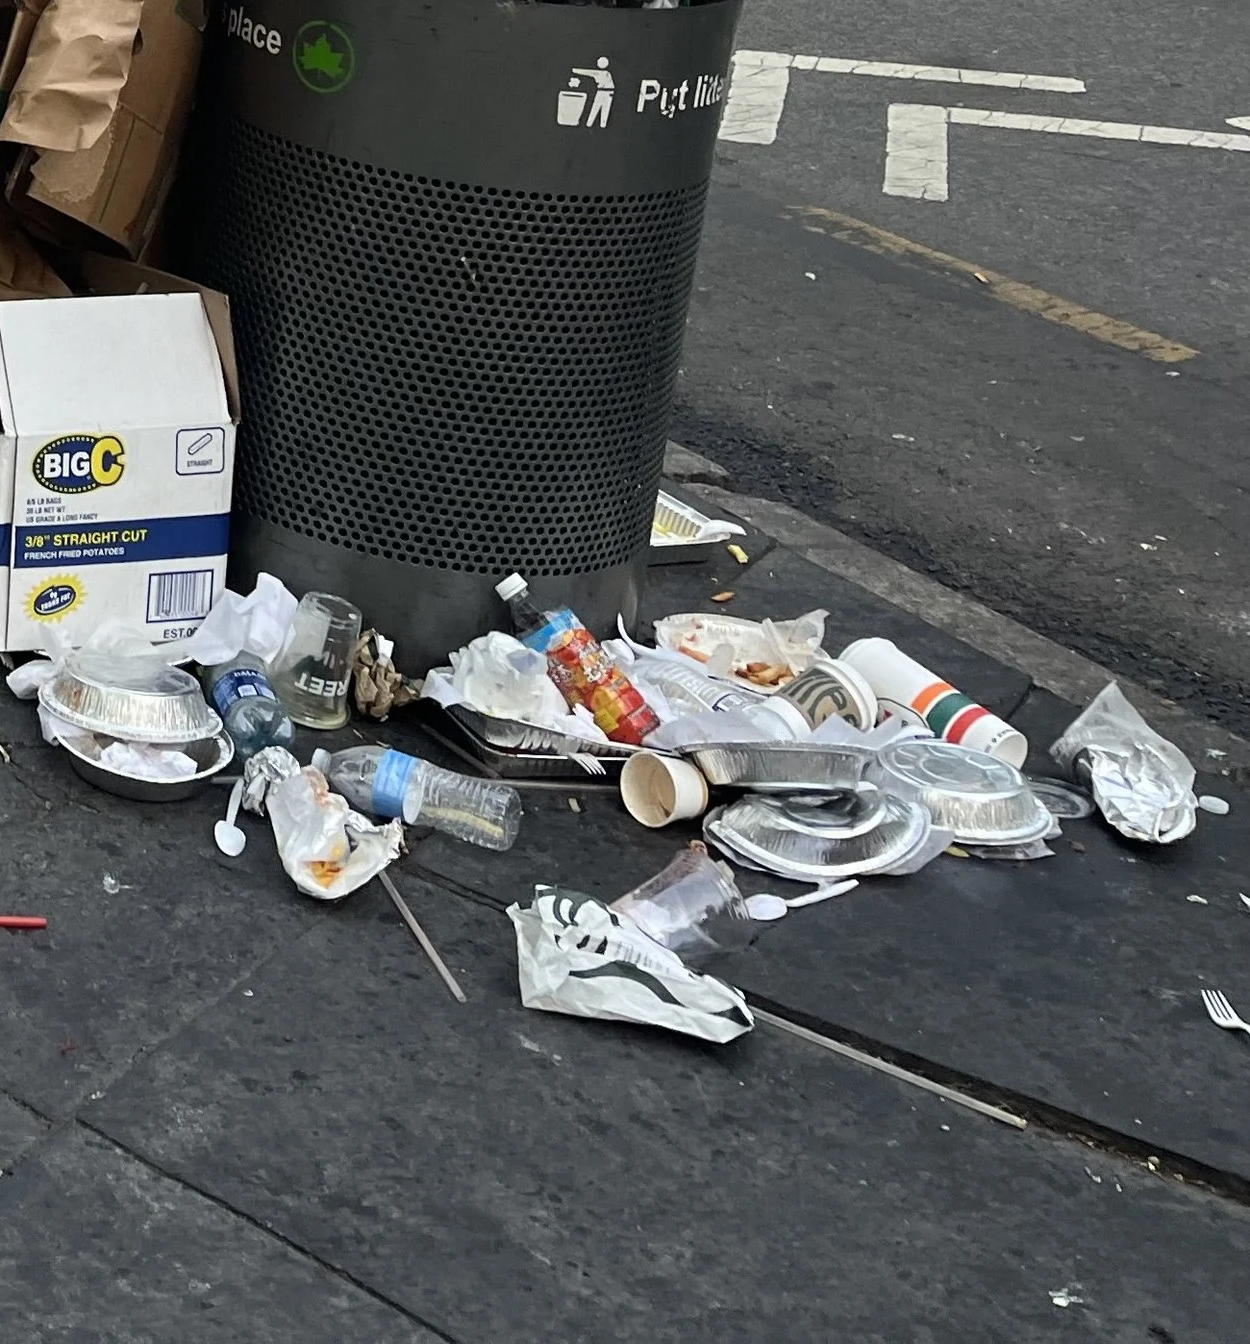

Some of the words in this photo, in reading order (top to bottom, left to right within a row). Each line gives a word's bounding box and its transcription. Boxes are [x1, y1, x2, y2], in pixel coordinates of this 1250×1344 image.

[228, 6, 282, 54] place
[54, 531, 118, 546] STRAIGHT
[121, 529, 147, 542] CUT
[24, 551, 57, 560] FRENCH
[58, 549, 81, 558] FRIED
[83, 547, 124, 556] POTATOES
